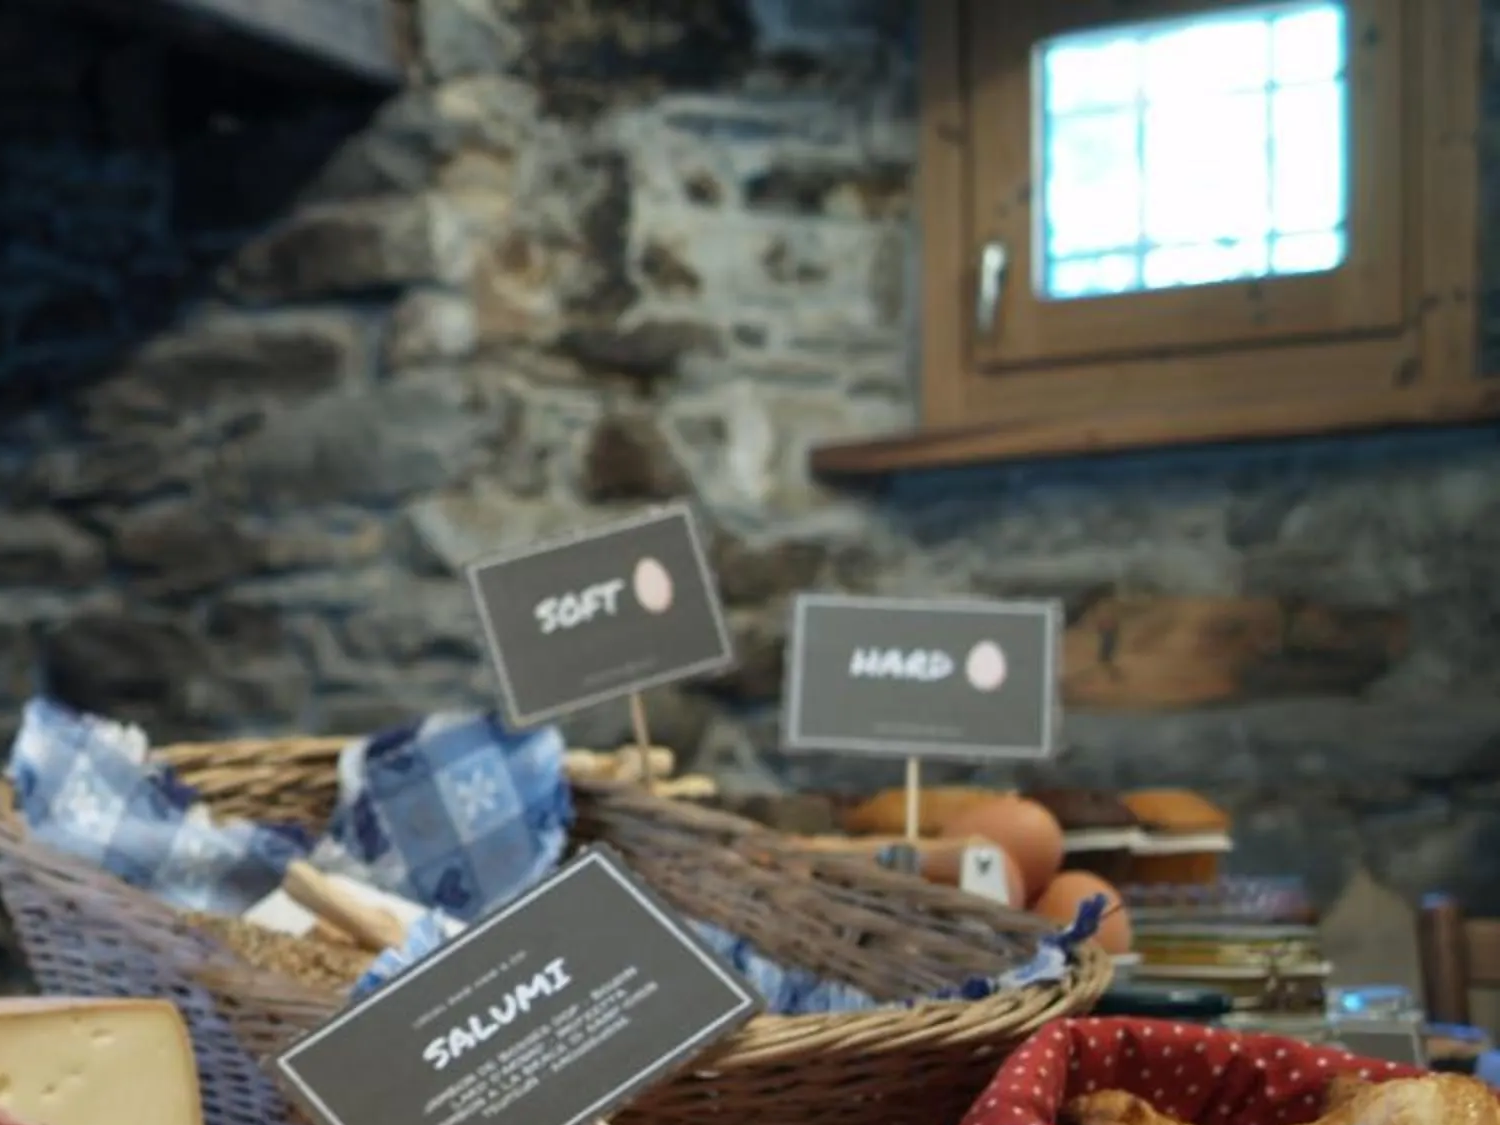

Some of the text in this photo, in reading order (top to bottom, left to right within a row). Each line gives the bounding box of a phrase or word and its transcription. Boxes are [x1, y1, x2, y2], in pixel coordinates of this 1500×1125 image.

[534, 579, 625, 634] SOFT
[851, 648, 954, 682] HARD
[421, 956, 574, 1071] SALUMI
